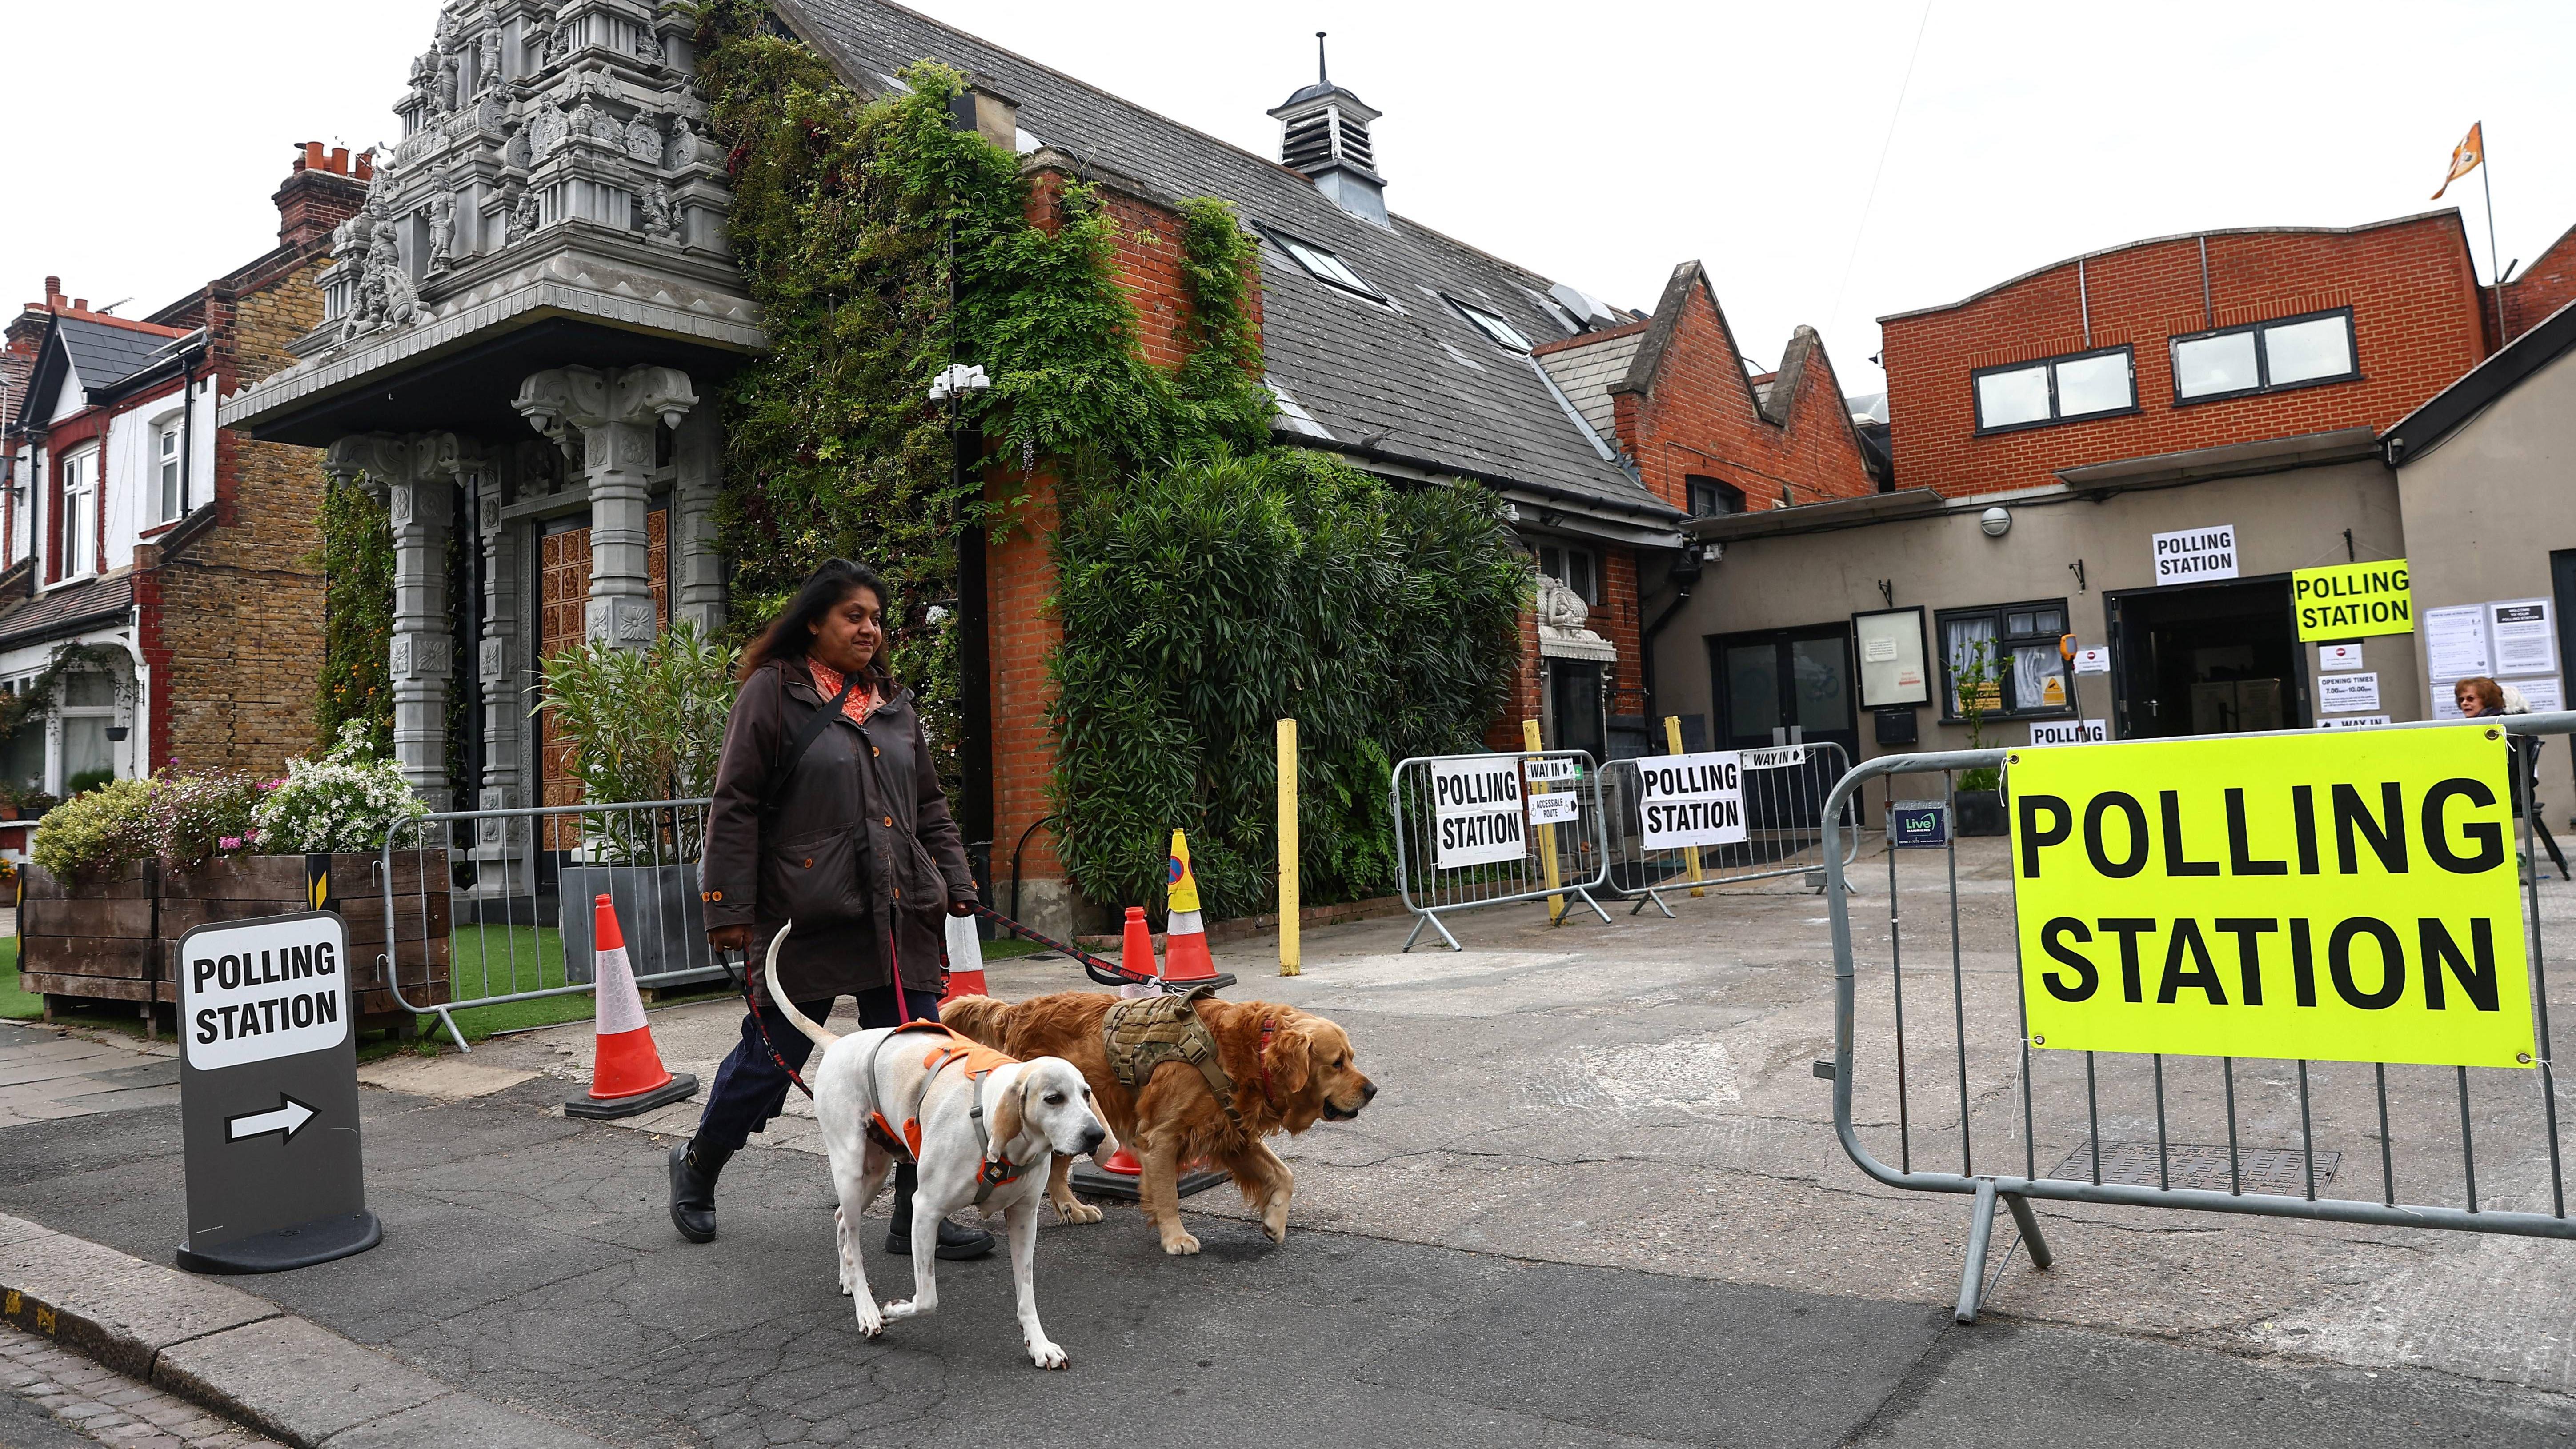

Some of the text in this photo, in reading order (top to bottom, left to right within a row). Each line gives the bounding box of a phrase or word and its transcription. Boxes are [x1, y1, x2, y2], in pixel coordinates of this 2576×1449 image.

[2158, 532, 2231, 555] POLLING
[2160, 553, 2232, 575] STATION
[2296, 570, 2409, 600] POLLING
[2302, 600, 2408, 628] STATION
[2034, 726, 2103, 744] POLLING
[1530, 762, 1560, 778] WAY IN
[1753, 751, 1789, 766] WAY IN
[1437, 771, 1517, 806] POLLING
[1643, 763, 1737, 797] POLLING
[1537, 798, 1563, 809] ACCESSIBLE
[1543, 809, 1558, 818] ROUTE
[1648, 801, 1739, 833] STATION
[1443, 812, 1520, 850] STATION
[1906, 818, 1931, 829] Live
[2018, 778, 2504, 878] POLLING
[193, 941, 336, 994] POLLING
[2040, 916, 2500, 1012] STATION
[196, 990, 337, 1045] STATION
